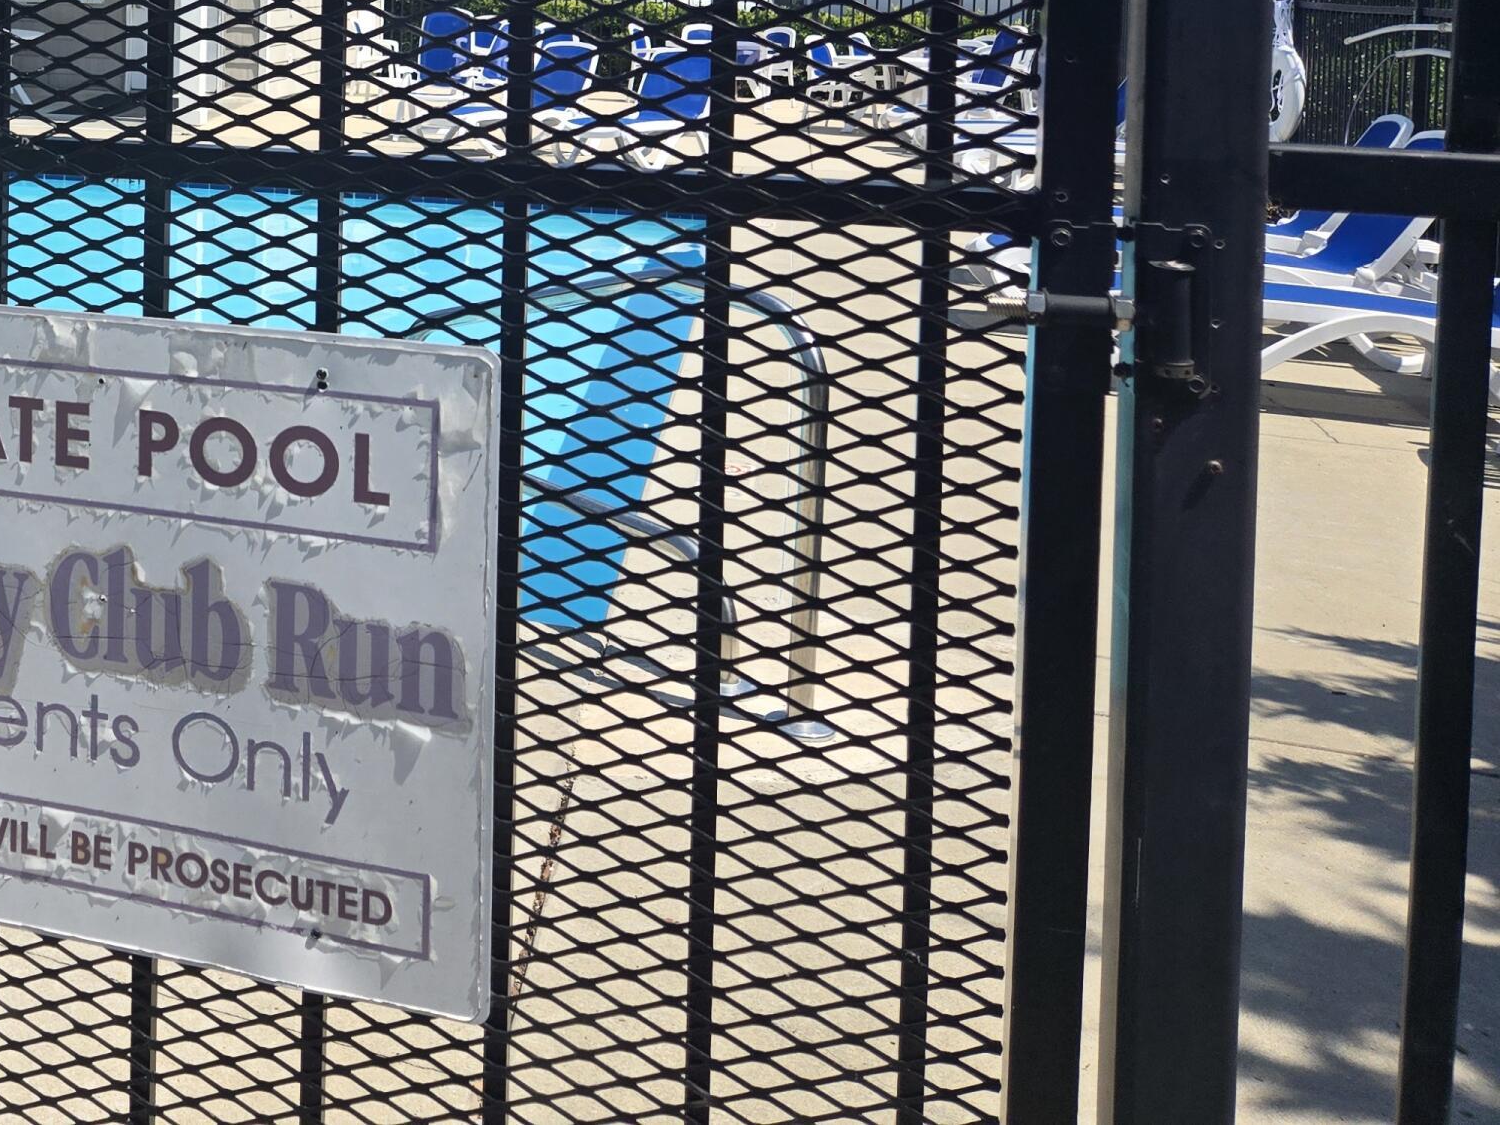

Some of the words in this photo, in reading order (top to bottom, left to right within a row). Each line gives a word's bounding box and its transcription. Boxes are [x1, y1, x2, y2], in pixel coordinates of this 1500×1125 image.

[138, 409, 390, 506] POOL
[50, 548, 243, 682] Club
[270, 580, 459, 720] Run
[173, 712, 349, 824] Only
[70, 834, 112, 870] BE
[128, 844, 393, 926] PROSECUTED
